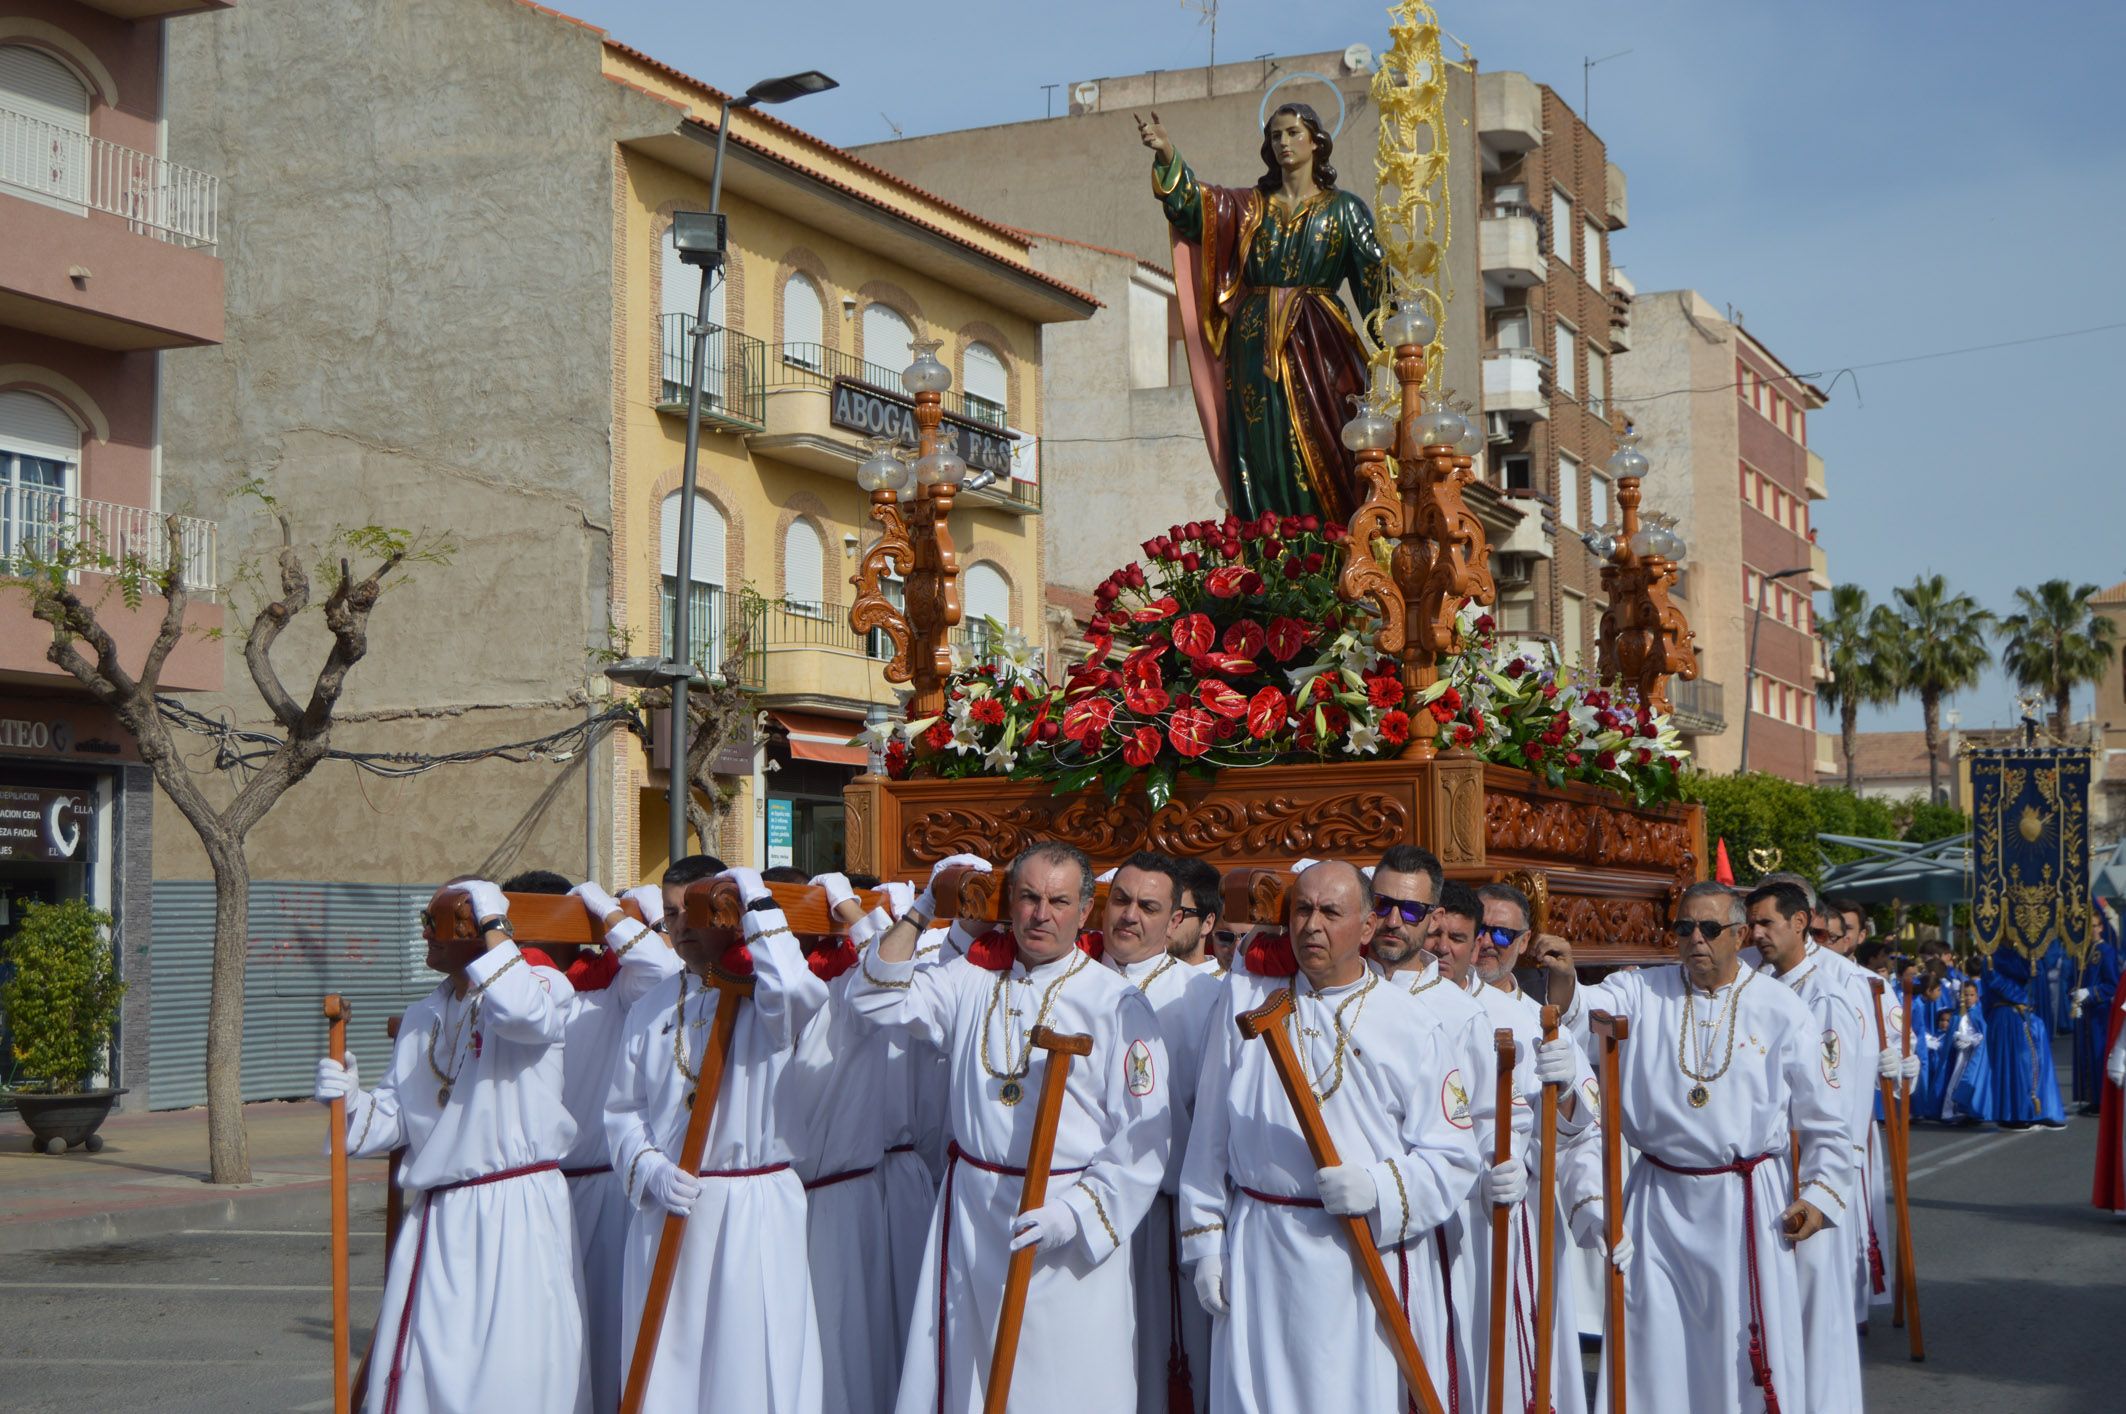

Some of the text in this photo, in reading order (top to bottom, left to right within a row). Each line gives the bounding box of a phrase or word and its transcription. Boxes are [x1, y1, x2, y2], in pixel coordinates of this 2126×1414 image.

[969, 431, 1011, 472] F&S
[22, 810, 41, 820] CERA
[74, 805, 94, 815] ELLA
[13, 828, 38, 838] FACIAL
[48, 847, 59, 857] EL
